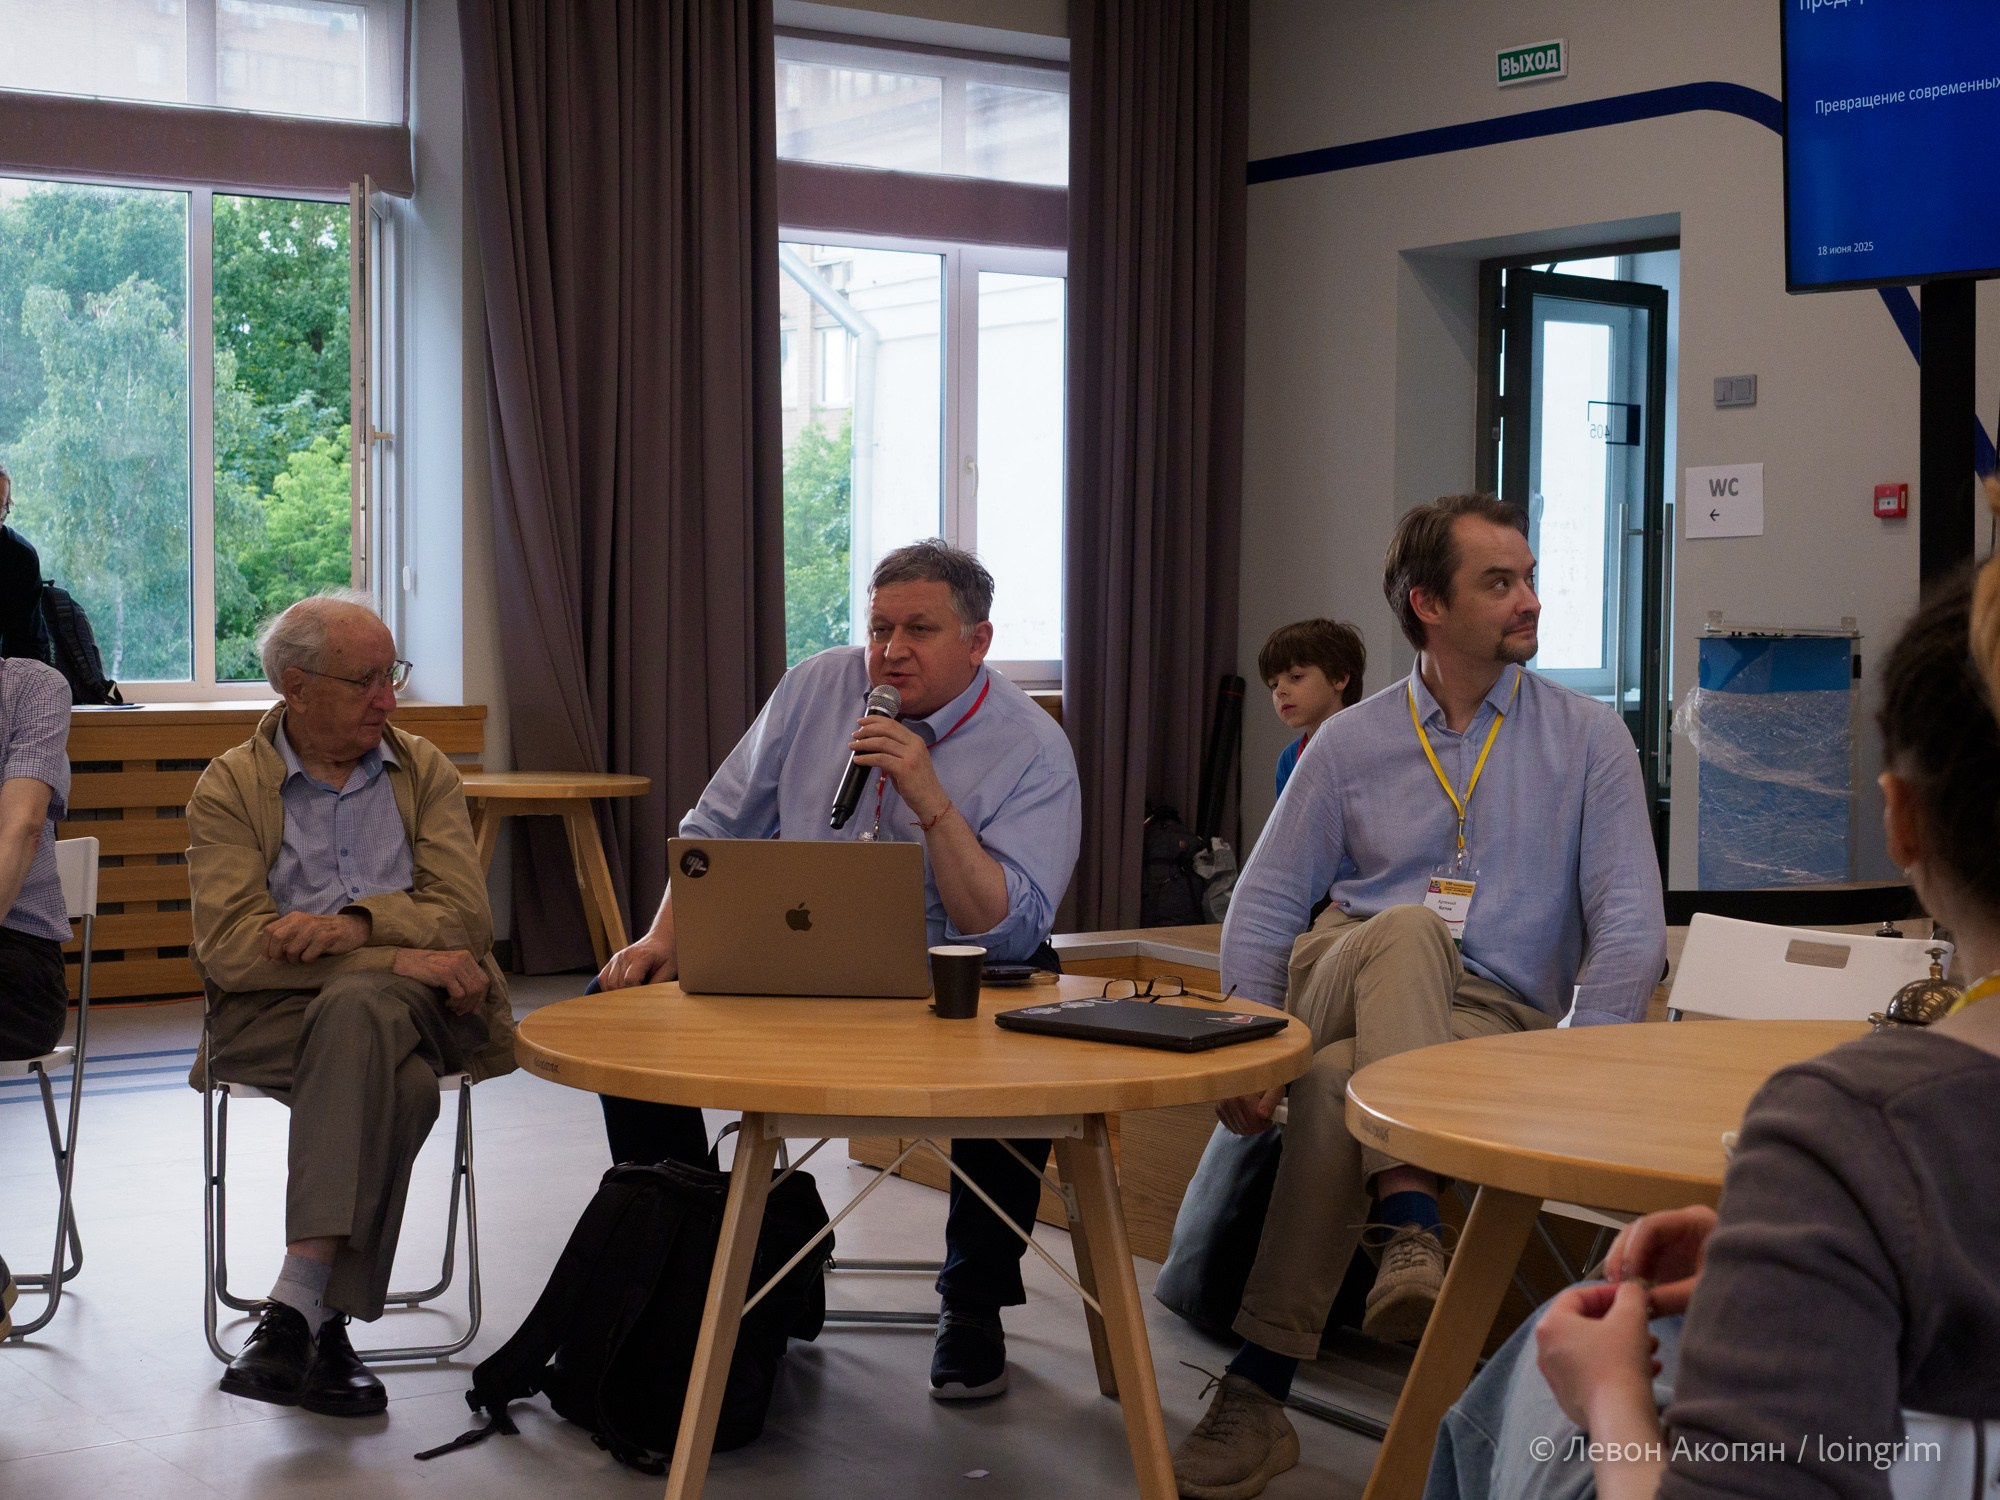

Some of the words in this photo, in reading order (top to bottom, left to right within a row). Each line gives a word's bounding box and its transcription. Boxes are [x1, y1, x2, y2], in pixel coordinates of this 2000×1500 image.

[1501, 49, 1558, 77] ВЫХОД
[1815, 91, 1905, 116] Превращение
[1818, 246, 1828, 256] 18
[1829, 246, 1852, 255] июня
[1853, 242, 1874, 253] 2025
[1709, 477, 1739, 497] WC
